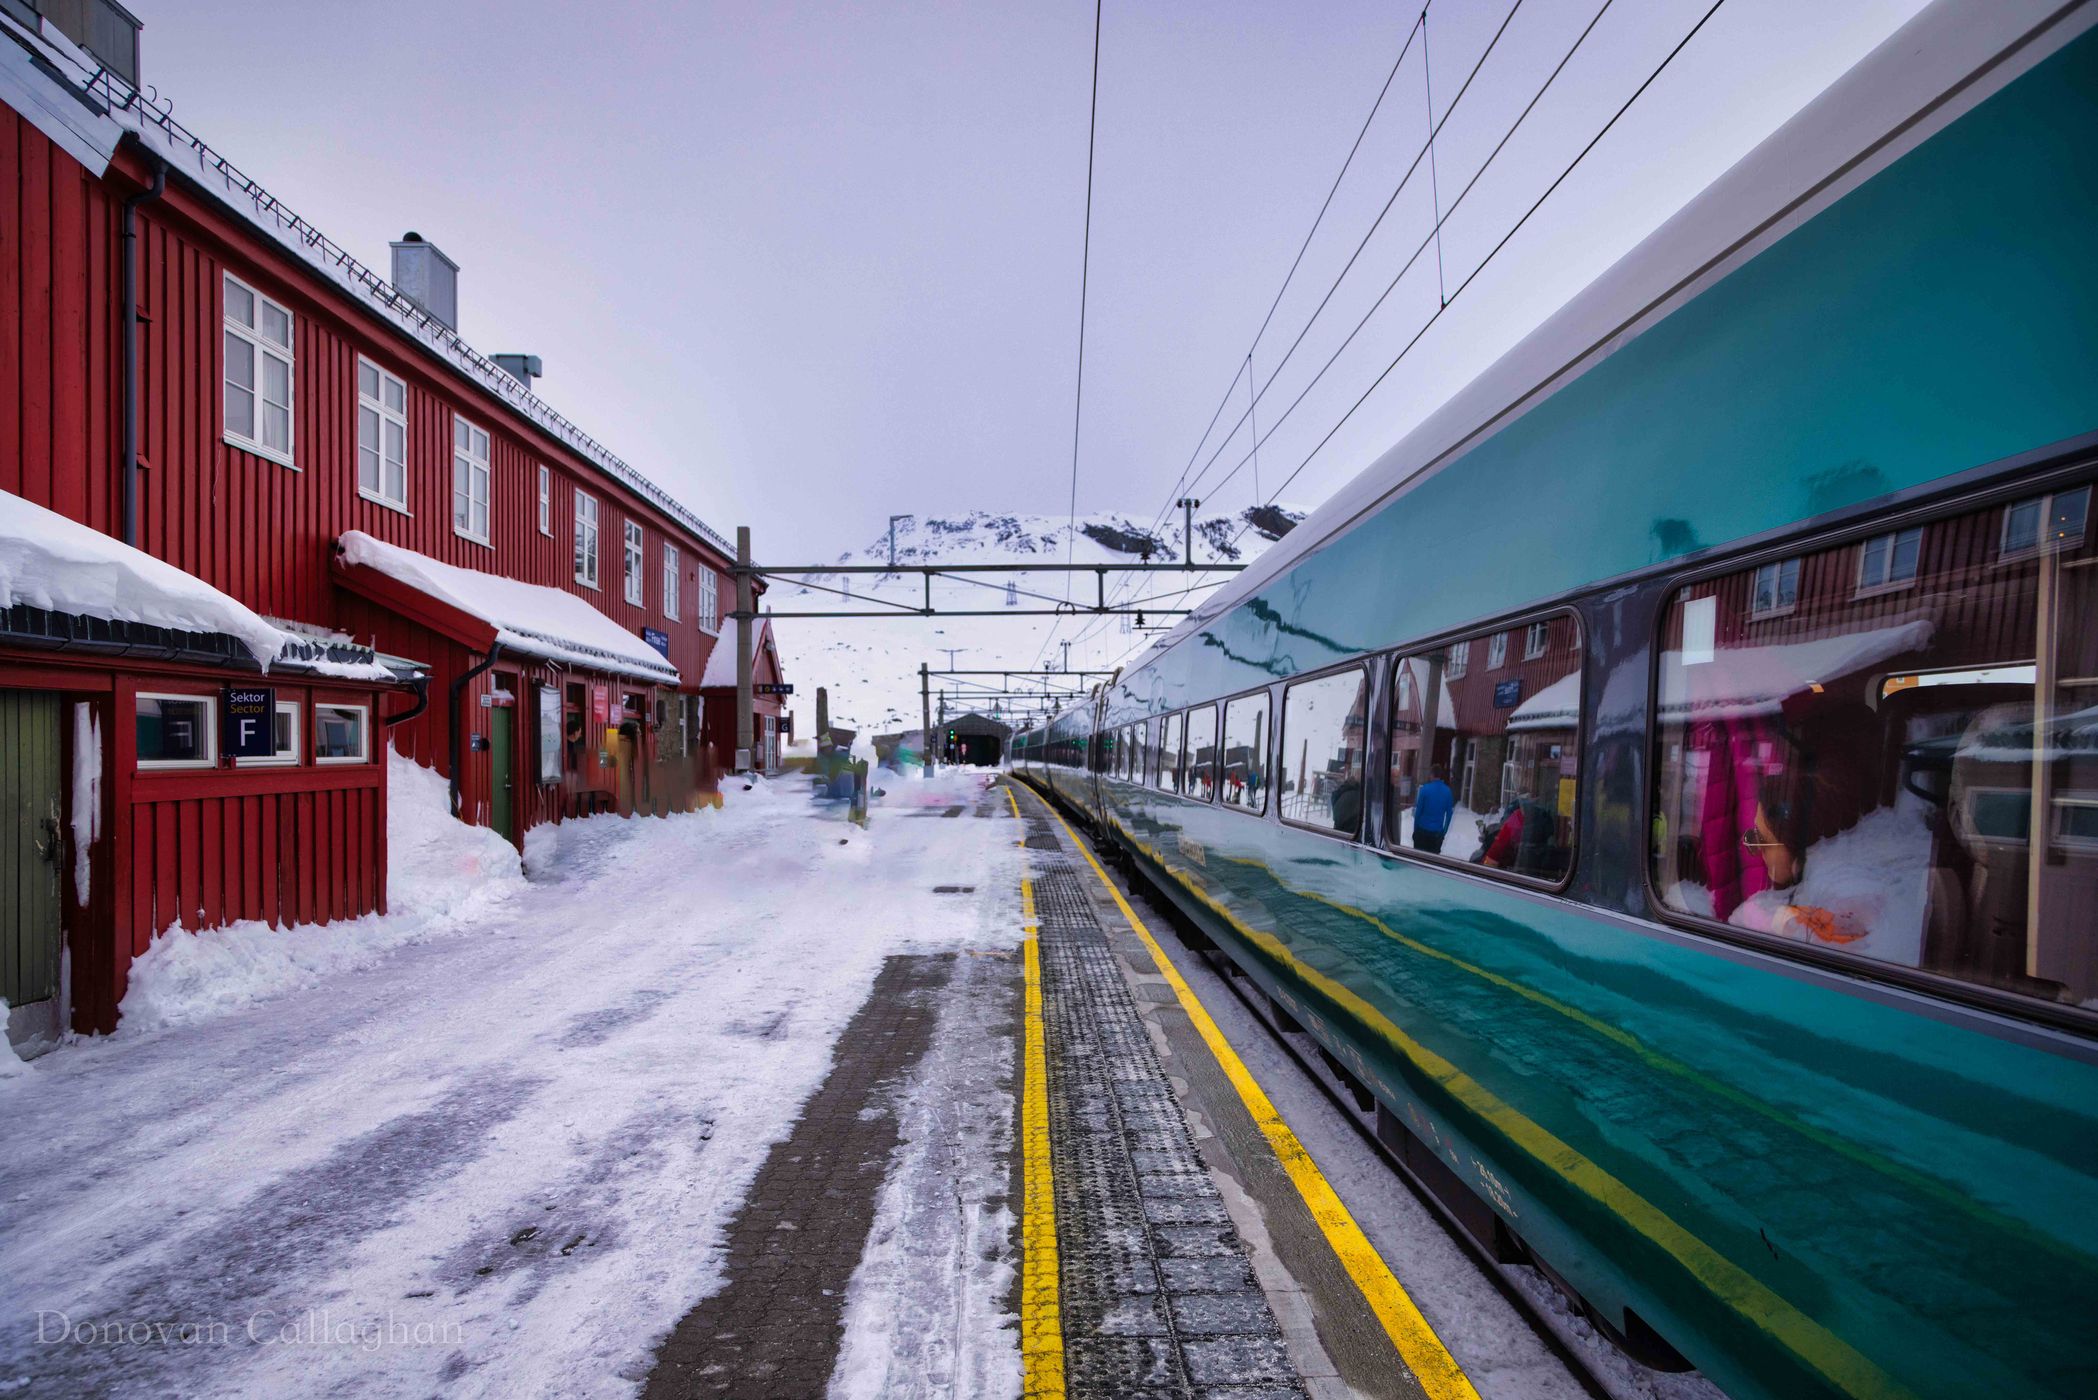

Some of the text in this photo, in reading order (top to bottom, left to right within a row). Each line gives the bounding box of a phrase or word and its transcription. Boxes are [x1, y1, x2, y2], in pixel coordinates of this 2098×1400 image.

[230, 692, 265, 702] Sektor
[230, 704, 265, 713] Sector
[782, 723, 789, 731] G
[241, 719, 256, 747] F
